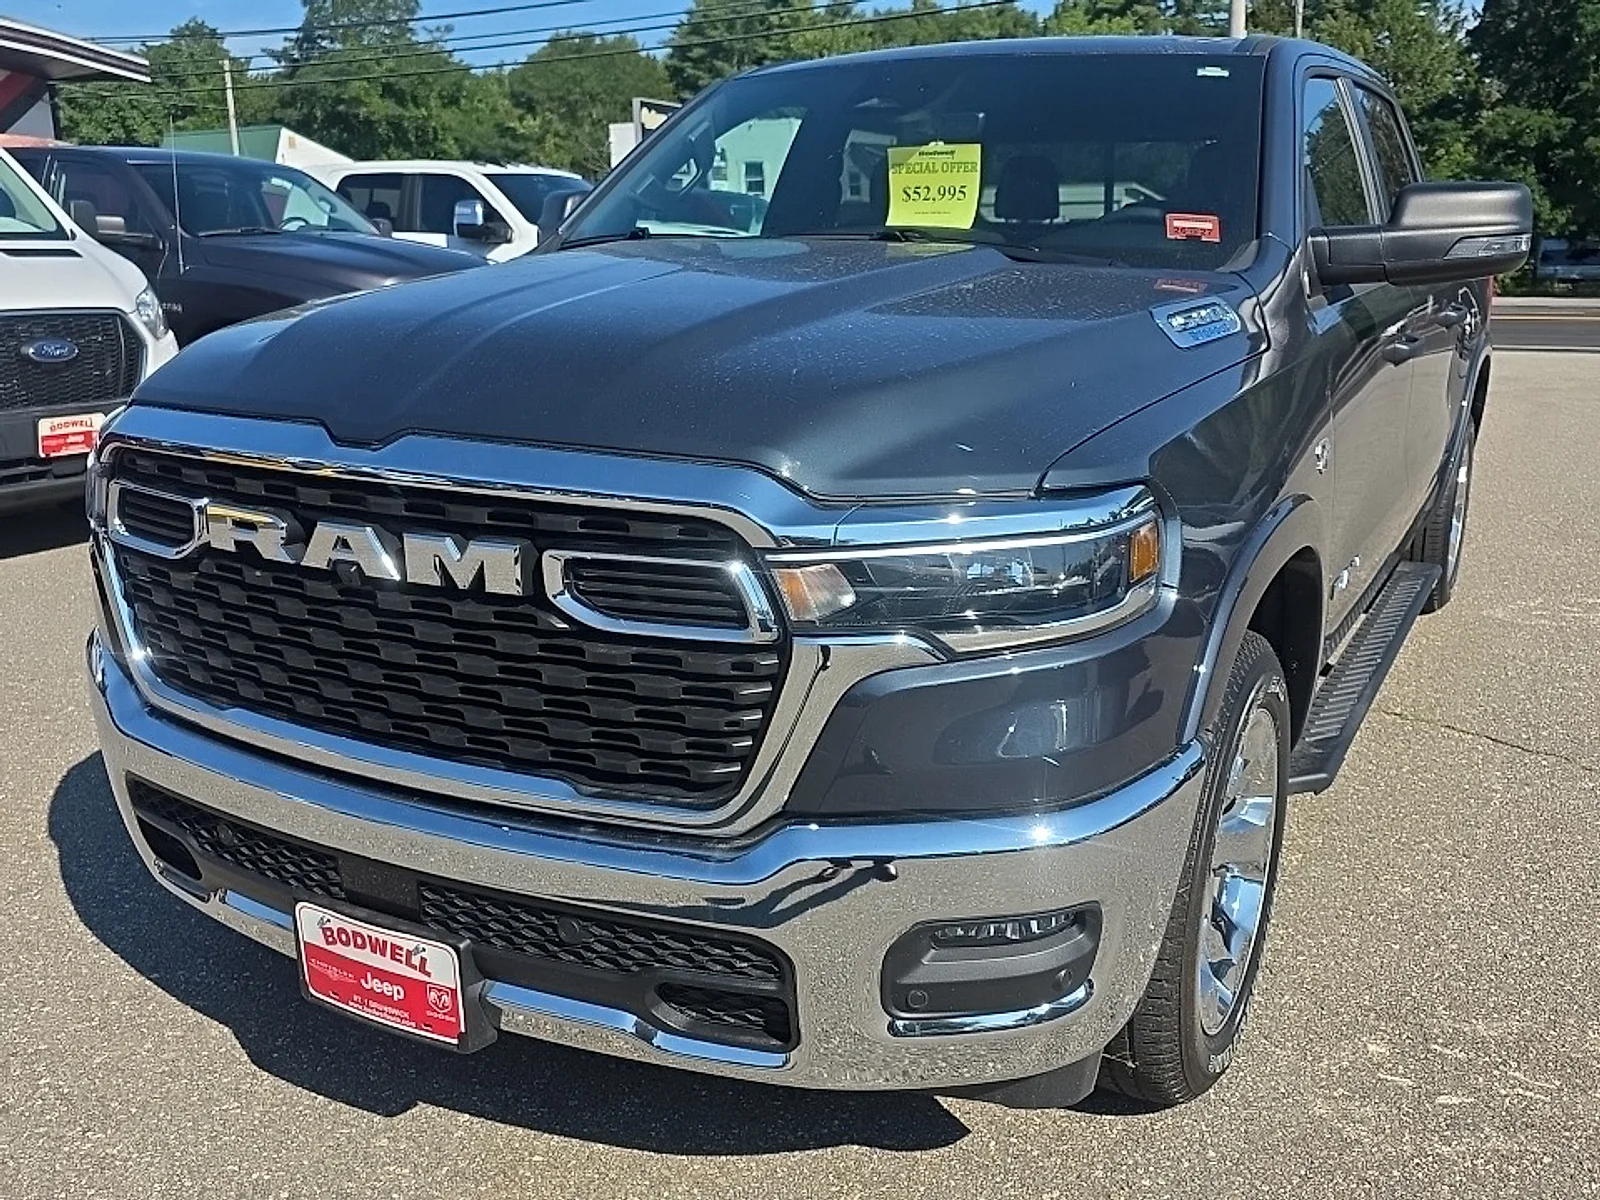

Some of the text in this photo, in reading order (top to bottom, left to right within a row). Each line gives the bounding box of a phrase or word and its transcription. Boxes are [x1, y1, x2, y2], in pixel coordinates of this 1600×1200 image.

[891, 161, 978, 175] SPECIAL OFFER
[901, 184, 968, 203] $52,995
[206, 502, 523, 597] RAM
[321, 926, 432, 978] BODWELL
[360, 972, 405, 1001] Jeep
